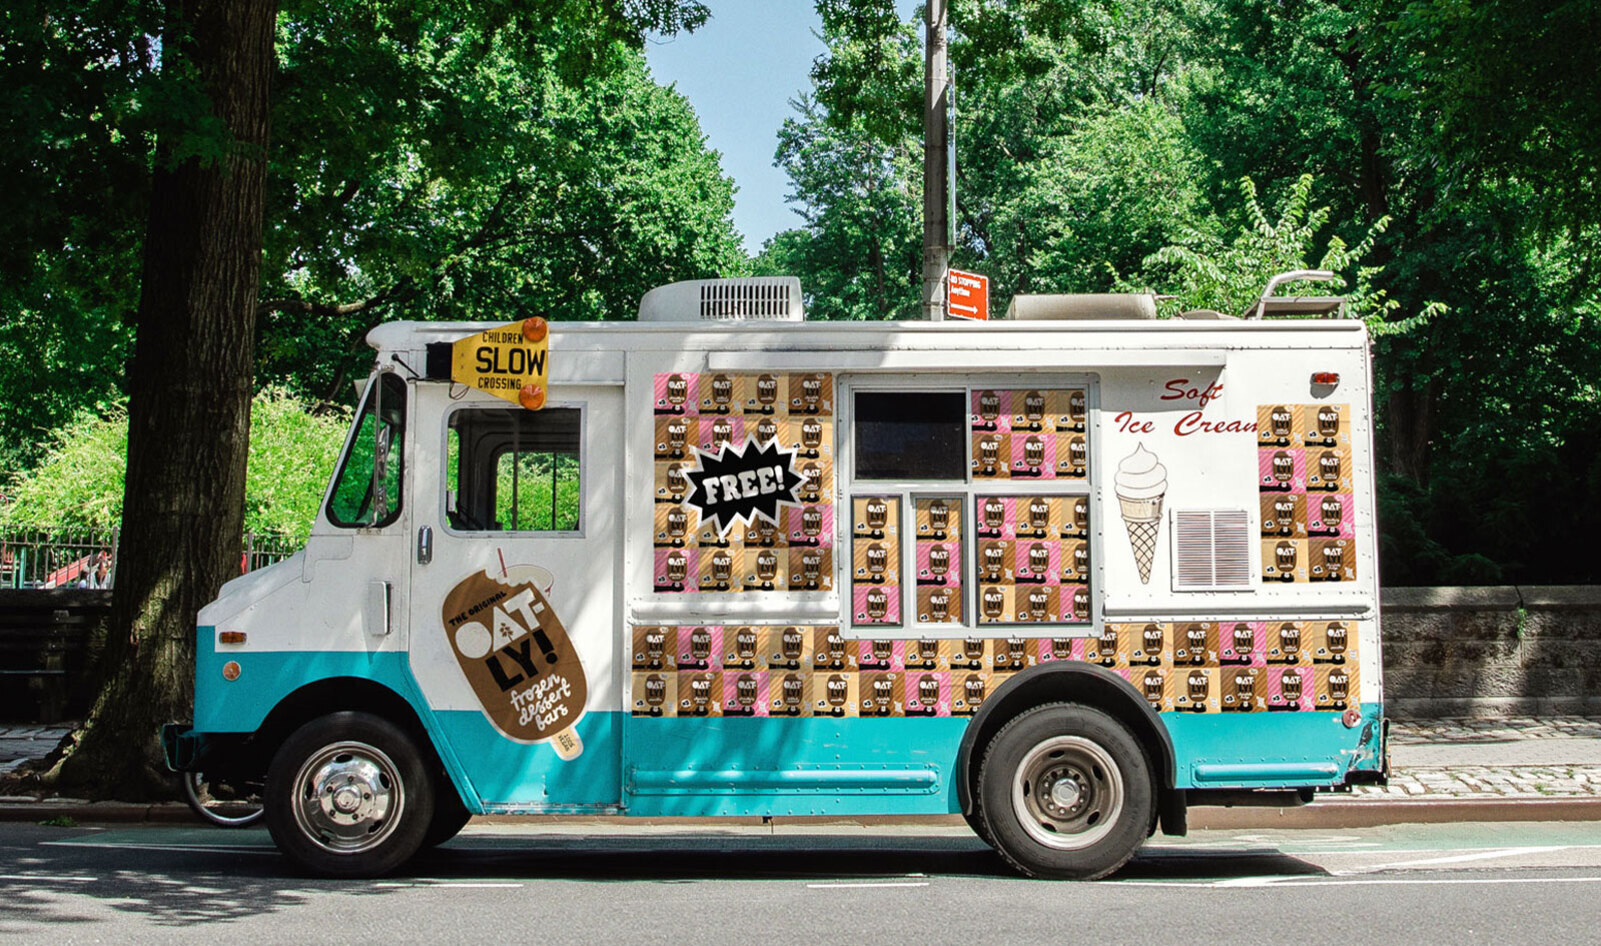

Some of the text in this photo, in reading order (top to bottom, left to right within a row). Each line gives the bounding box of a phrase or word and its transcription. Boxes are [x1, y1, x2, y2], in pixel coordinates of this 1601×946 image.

[483, 331, 523, 344] CHILDREN
[476, 347, 546, 376] SLOW
[478, 377, 521, 390] CROSSING
[1160, 379, 1224, 407] Soft
[1114, 411, 1155, 433] Ice
[702, 465, 785, 505] FREE!
[449, 591, 507, 627] THE ORIGINAL
[485, 628, 558, 692] LY!
[510, 674, 560, 711] frozen
[519, 678, 571, 726] dessert
[535, 703, 569, 731] bars
